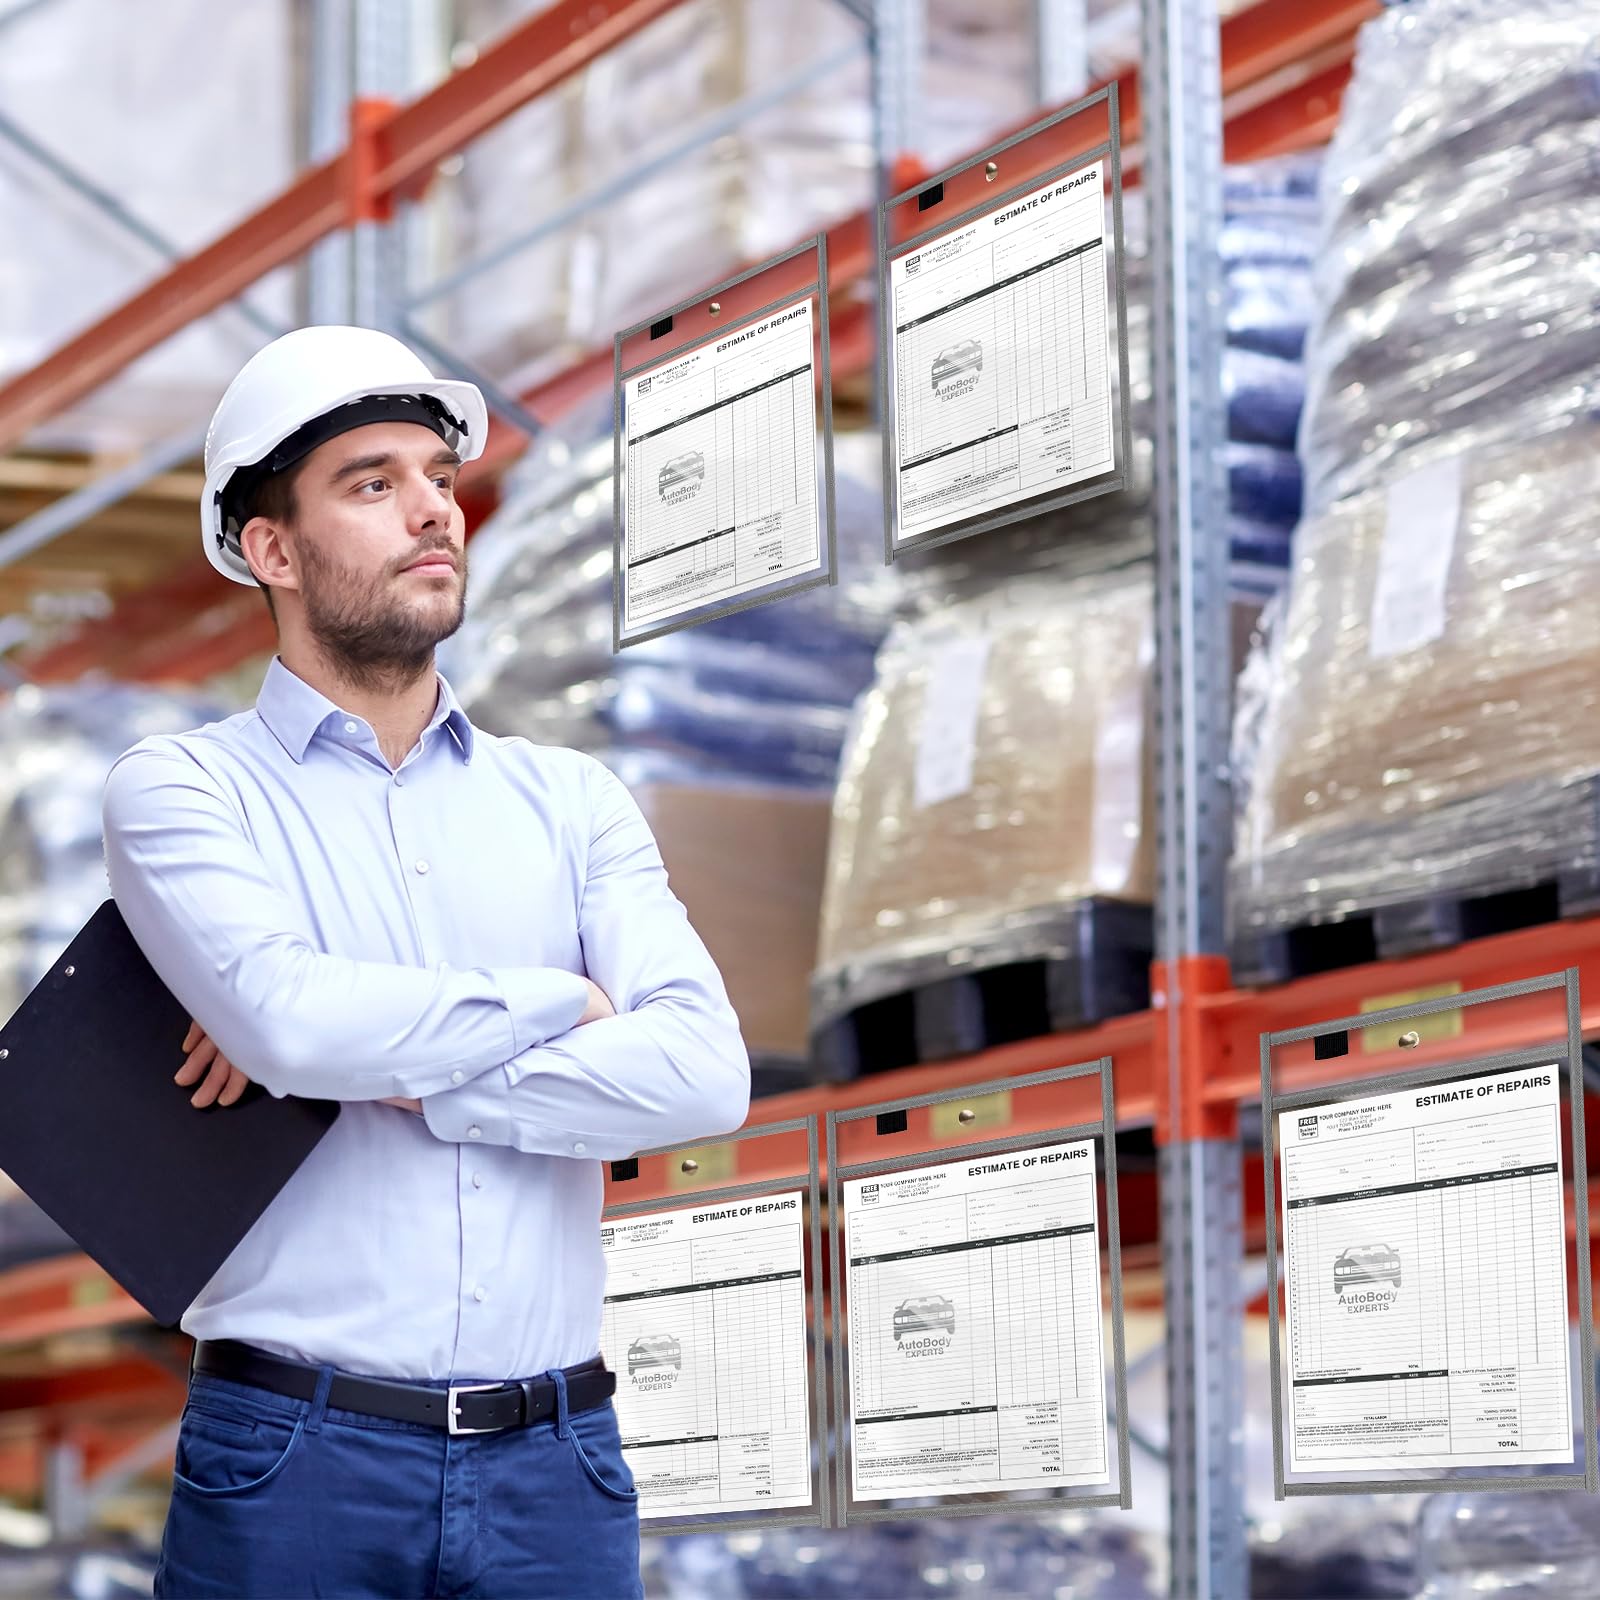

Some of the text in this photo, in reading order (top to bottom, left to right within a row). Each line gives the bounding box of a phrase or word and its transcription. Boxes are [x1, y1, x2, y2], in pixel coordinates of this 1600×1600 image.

[994, 170, 1097, 226] ESTIMATE OF REPAIRS
[717, 306, 807, 353] ESTIMATE OF REPAIRS
[935, 374, 980, 398] AutoBody
[942, 384, 974, 403] EXPERTS
[1056, 464, 1072, 475] TOTAL
[661, 481, 702, 503] AutoBody
[768, 562, 783, 571] TOTAL
[1416, 1075, 1551, 1108] ESTIMATE OF REPAIRS
[1319, 1103, 1392, 1121] YOUR COMPANY NAME HERE
[1300, 1117, 1317, 1126] FREE
[968, 1148, 1088, 1177] ESTIMATE OF REPAIRS
[863, 1185, 878, 1193] FREE
[692, 1199, 797, 1224] ESTIMATE OF REPAIRS
[1338, 1290, 1398, 1305] AutoBody
[1347, 1302, 1390, 1314] EXPERTS
[897, 1336, 952, 1351] AutoBody
[906, 1347, 944, 1359] EXPERTS
[632, 1371, 679, 1385] AutoBody
[639, 1382, 673, 1392] EXPERTS
